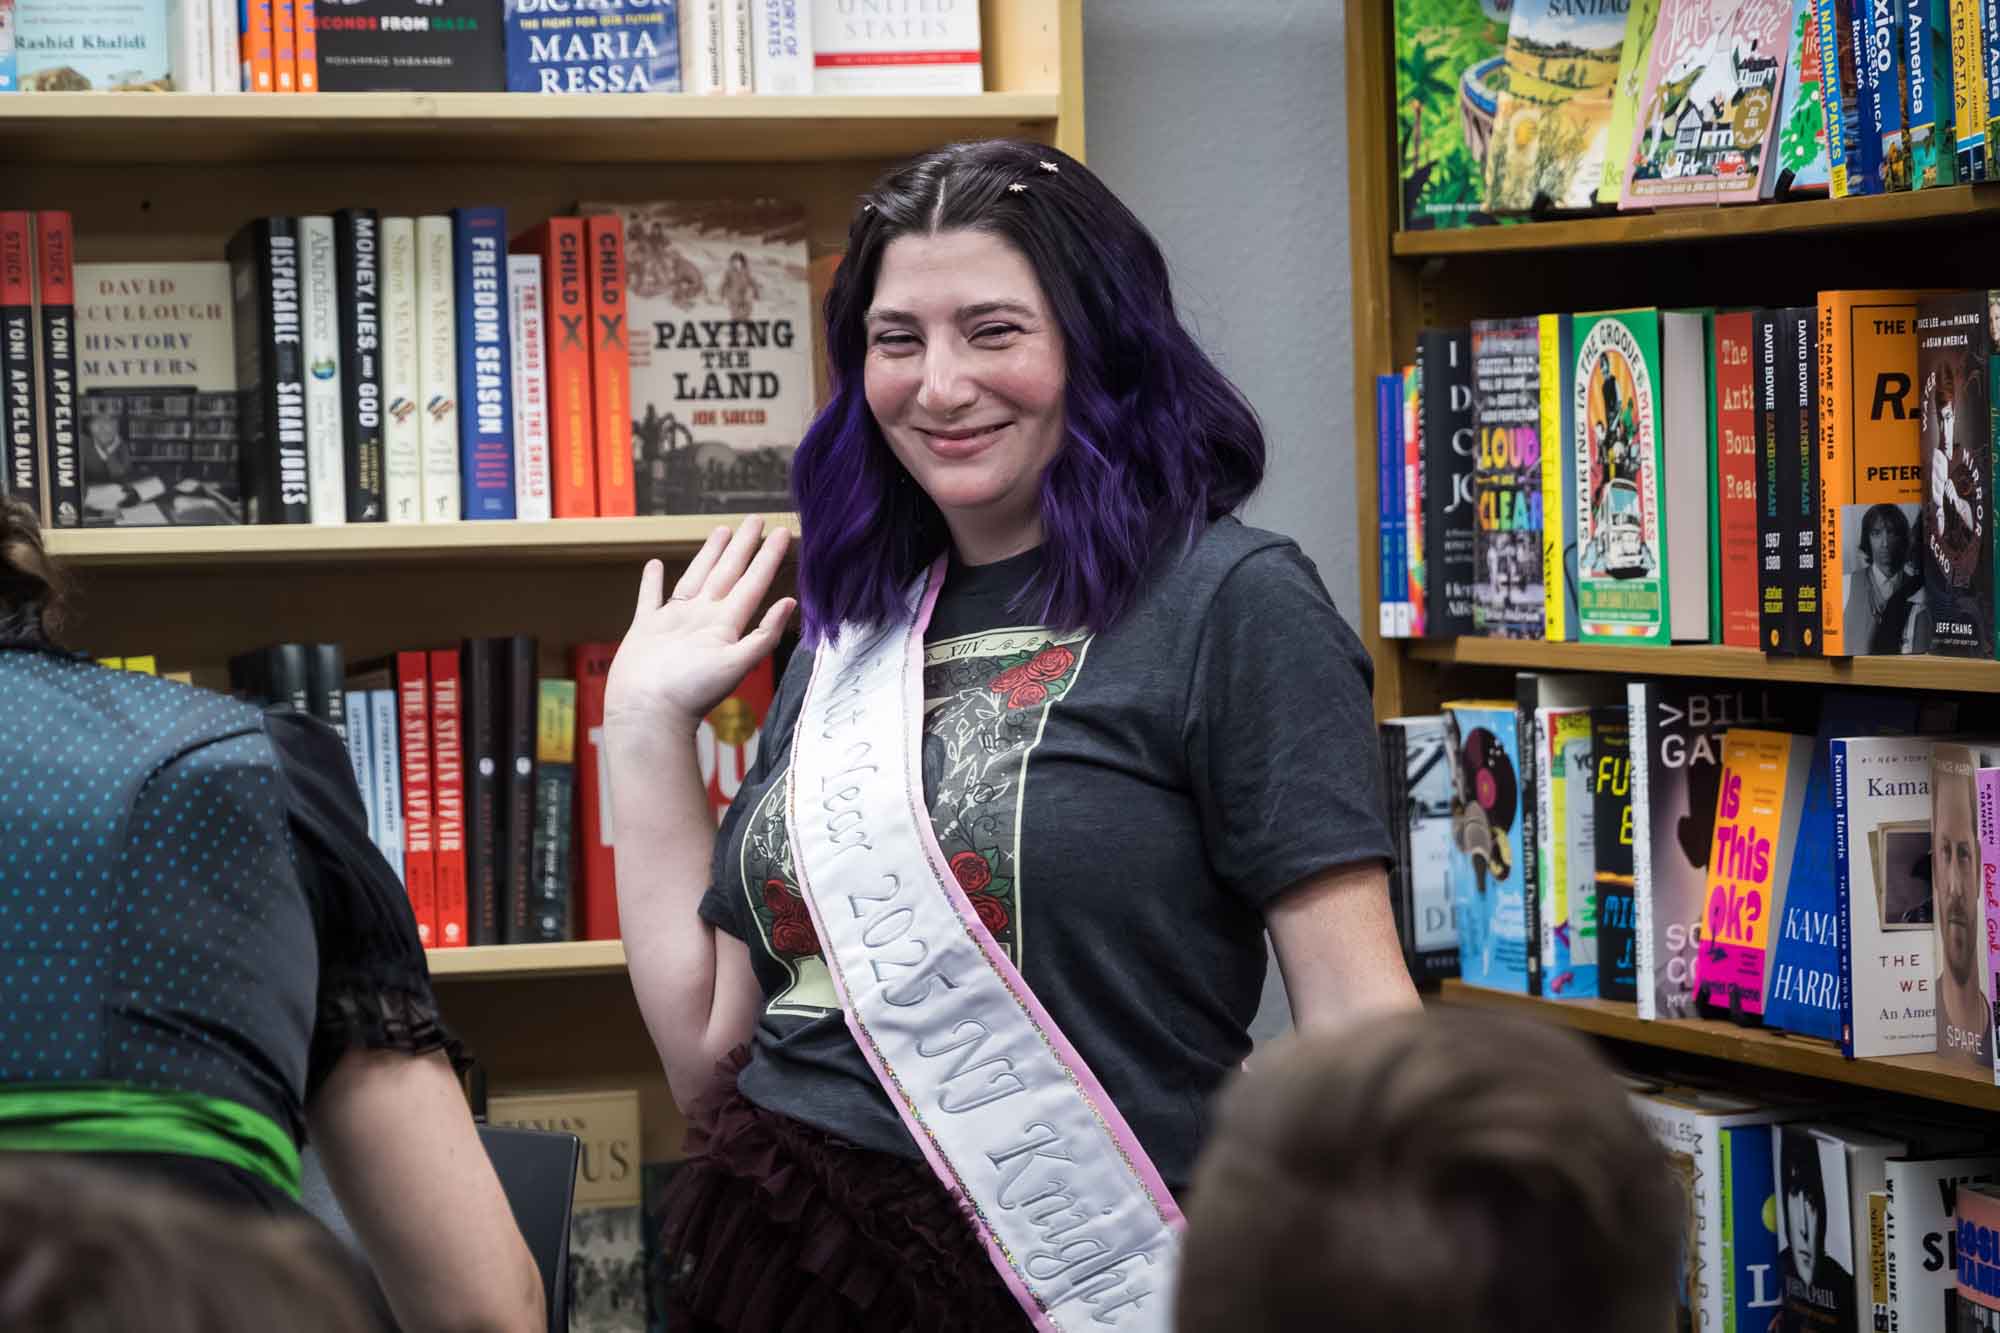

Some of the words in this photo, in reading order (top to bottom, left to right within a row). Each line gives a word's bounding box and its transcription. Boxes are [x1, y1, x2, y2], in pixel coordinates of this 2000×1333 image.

[14, 34, 75, 49] Rashid
[82, 33, 147, 49] Khalidi
[381, 16, 429, 31] FROM
[1852, 19, 1862, 66] Route
[528, 31, 657, 63] MARIA
[1820, 11, 1837, 94] NATIONAL
[1869, 34, 1880, 89] COSTA
[1908, 13, 1926, 114] America
[1956, 0, 1968, 110] CROATIA
[540, 65, 650, 93] RESSA
[1989, 48, 2000, 100] Asia
[1828, 102, 1841, 160] PARKS
[1872, 93, 1883, 133] RICA
[356, 217, 376, 297] MONEY,
[559, 233, 579, 304] CHILD
[599, 233, 619, 304] CHILD
[98, 279, 176, 296] DAVID
[270, 236, 300, 344] DISPOSABLE
[311, 230, 330, 340] Abundance
[472, 236, 499, 343] FREEDOM
[85, 334, 193, 351] HISTORY
[356, 302, 378, 353] LIES,
[560, 314, 583, 350] X
[600, 314, 623, 349] X
[653, 320, 795, 349] PAYING
[1797, 319, 1807, 361] DAVID
[1825, 305, 1833, 336] THE
[1873, 319, 1906, 336] THE
[1926, 337, 1941, 347] ASIAN
[1941, 335, 1968, 346] AMERICA
[1929, 318, 1939, 328] LEE
[1954, 314, 1980, 326] MAKING
[702, 351, 750, 369] THE
[1599, 323, 1640, 371] GROOVE
[1721, 338, 1748, 365] The
[1764, 323, 1774, 364] DAVID
[82, 359, 198, 378] MATTERS
[672, 372, 779, 401] LAND
[1765, 366, 1776, 411] BOWIE
[1798, 362, 1808, 407] BOWIE
[1826, 344, 1834, 391] NAME
[277, 382, 306, 443] SARAH
[358, 382, 379, 428] GOD
[475, 347, 503, 434] SEASON
[1826, 396, 1834, 420] OF
[11, 370, 33, 489] APPELBAUM
[52, 369, 75, 488] APPELBAUM
[692, 409, 717, 426] JOE
[722, 409, 767, 425] SACCO
[1479, 427, 1540, 471] LOUD
[1765, 412, 1777, 518] RAINBOWMAN
[1799, 407, 1811, 516] RAINBOWMAN
[1827, 424, 1835, 461] THIS
[280, 449, 308, 505] JONES
[1867, 465, 1920, 482] PETER
[1828, 507, 1836, 561] PETER
[1935, 622, 1950, 634] JEFF
[1951, 623, 1973, 635] CHANG
[403, 679, 425, 715] THE
[435, 678, 457, 715] THE
[404, 718, 428, 784] STALIN
[436, 718, 460, 784] STALIN
[1719, 767, 1742, 821] Is
[1834, 753, 1846, 808] Kamala
[1867, 777, 1929, 797] Kama
[406, 788, 431, 853] AFFAIR
[437, 787, 463, 853] AFFAIR
[1836, 813, 1847, 860] Harris
[1985, 783, 1995, 846] KATHLEEN
[1715, 823, 1771, 884] This
[1983, 863, 1999, 909] Rebel
[1785, 907, 1838, 948] KAMA
[1986, 918, 2000, 956] Girl
[1879, 954, 1920, 968] THE
[1899, 979, 1929, 992] WE
[1879, 1007, 1898, 1020] An
[1946, 1024, 1983, 1056] SPARE
[847, 873, 959, 1009] 2025
[984, 1121, 1157, 1328] Knight
[1886, 1179, 1894, 1205] WE
[1694, 1133, 1711, 1327] MATRIARC
[1887, 1213, 1895, 1240] ALL
[1888, 1251, 1898, 1303] SHINE
